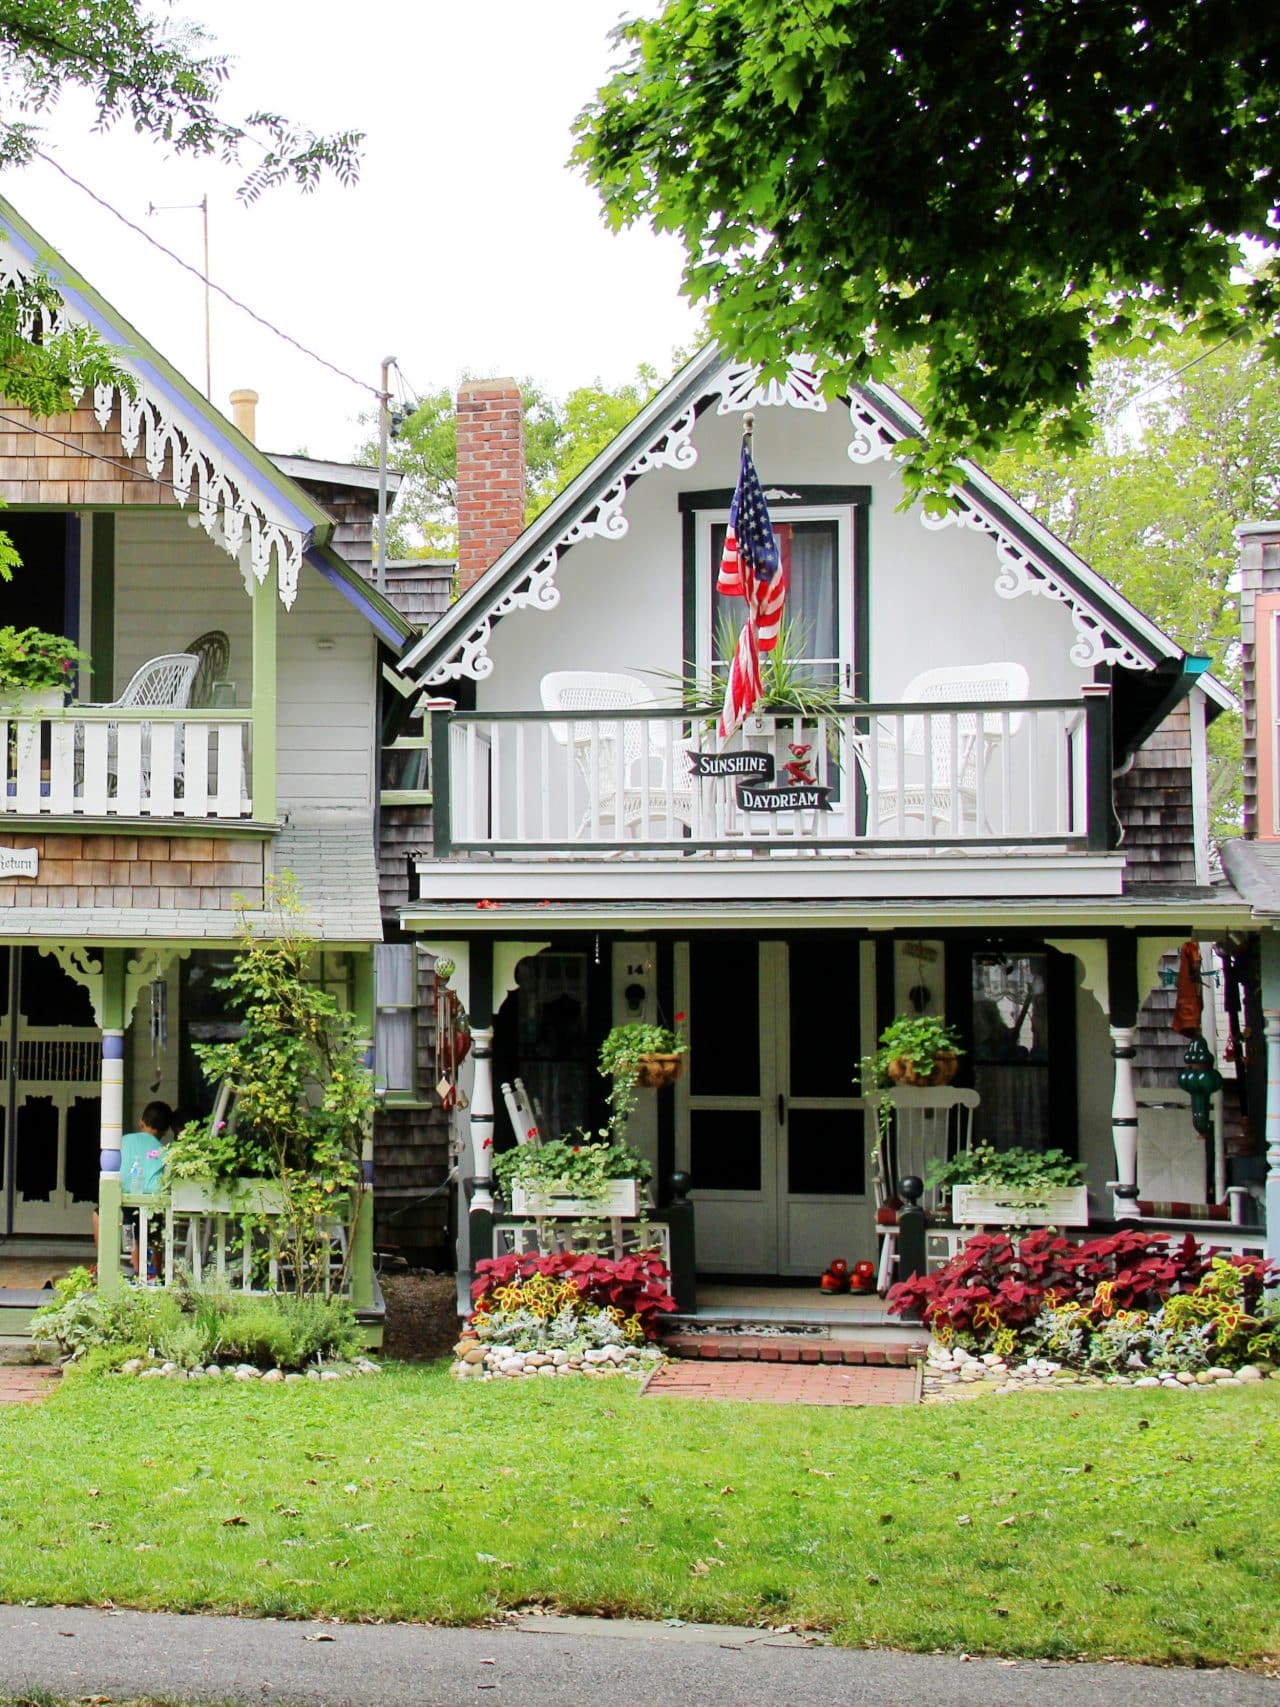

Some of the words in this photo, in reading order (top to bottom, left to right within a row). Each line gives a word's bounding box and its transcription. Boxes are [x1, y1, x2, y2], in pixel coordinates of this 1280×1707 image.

[700, 756, 767, 774] SUNSHINE
[742, 790, 819, 808] DAYDREAM
[627, 964, 644, 974] 14
